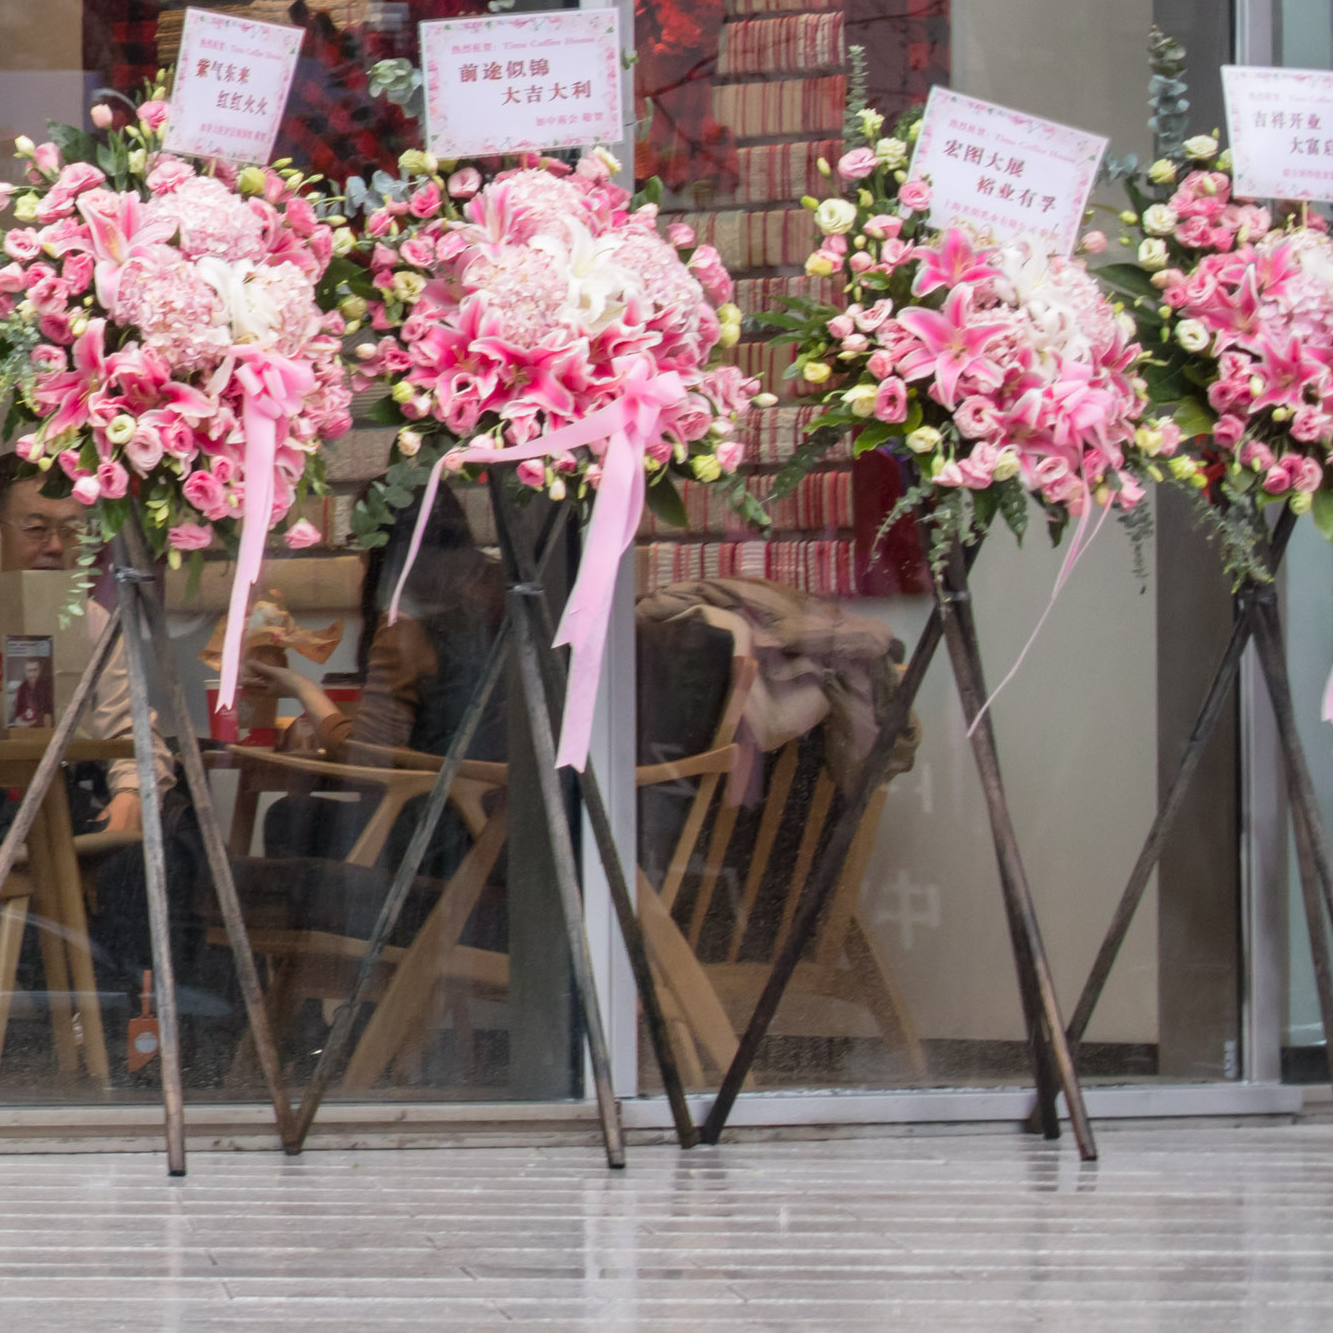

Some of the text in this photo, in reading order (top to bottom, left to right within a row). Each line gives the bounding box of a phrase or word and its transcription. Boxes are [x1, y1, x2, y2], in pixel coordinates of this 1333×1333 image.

[195, 57, 251, 86] 紫气东来
[459, 58, 550, 84] 前途似锦
[216, 89, 269, 116] 红红火火
[501, 80, 592, 106] 大吉大利
[942, 139, 1026, 178] 宏图大展
